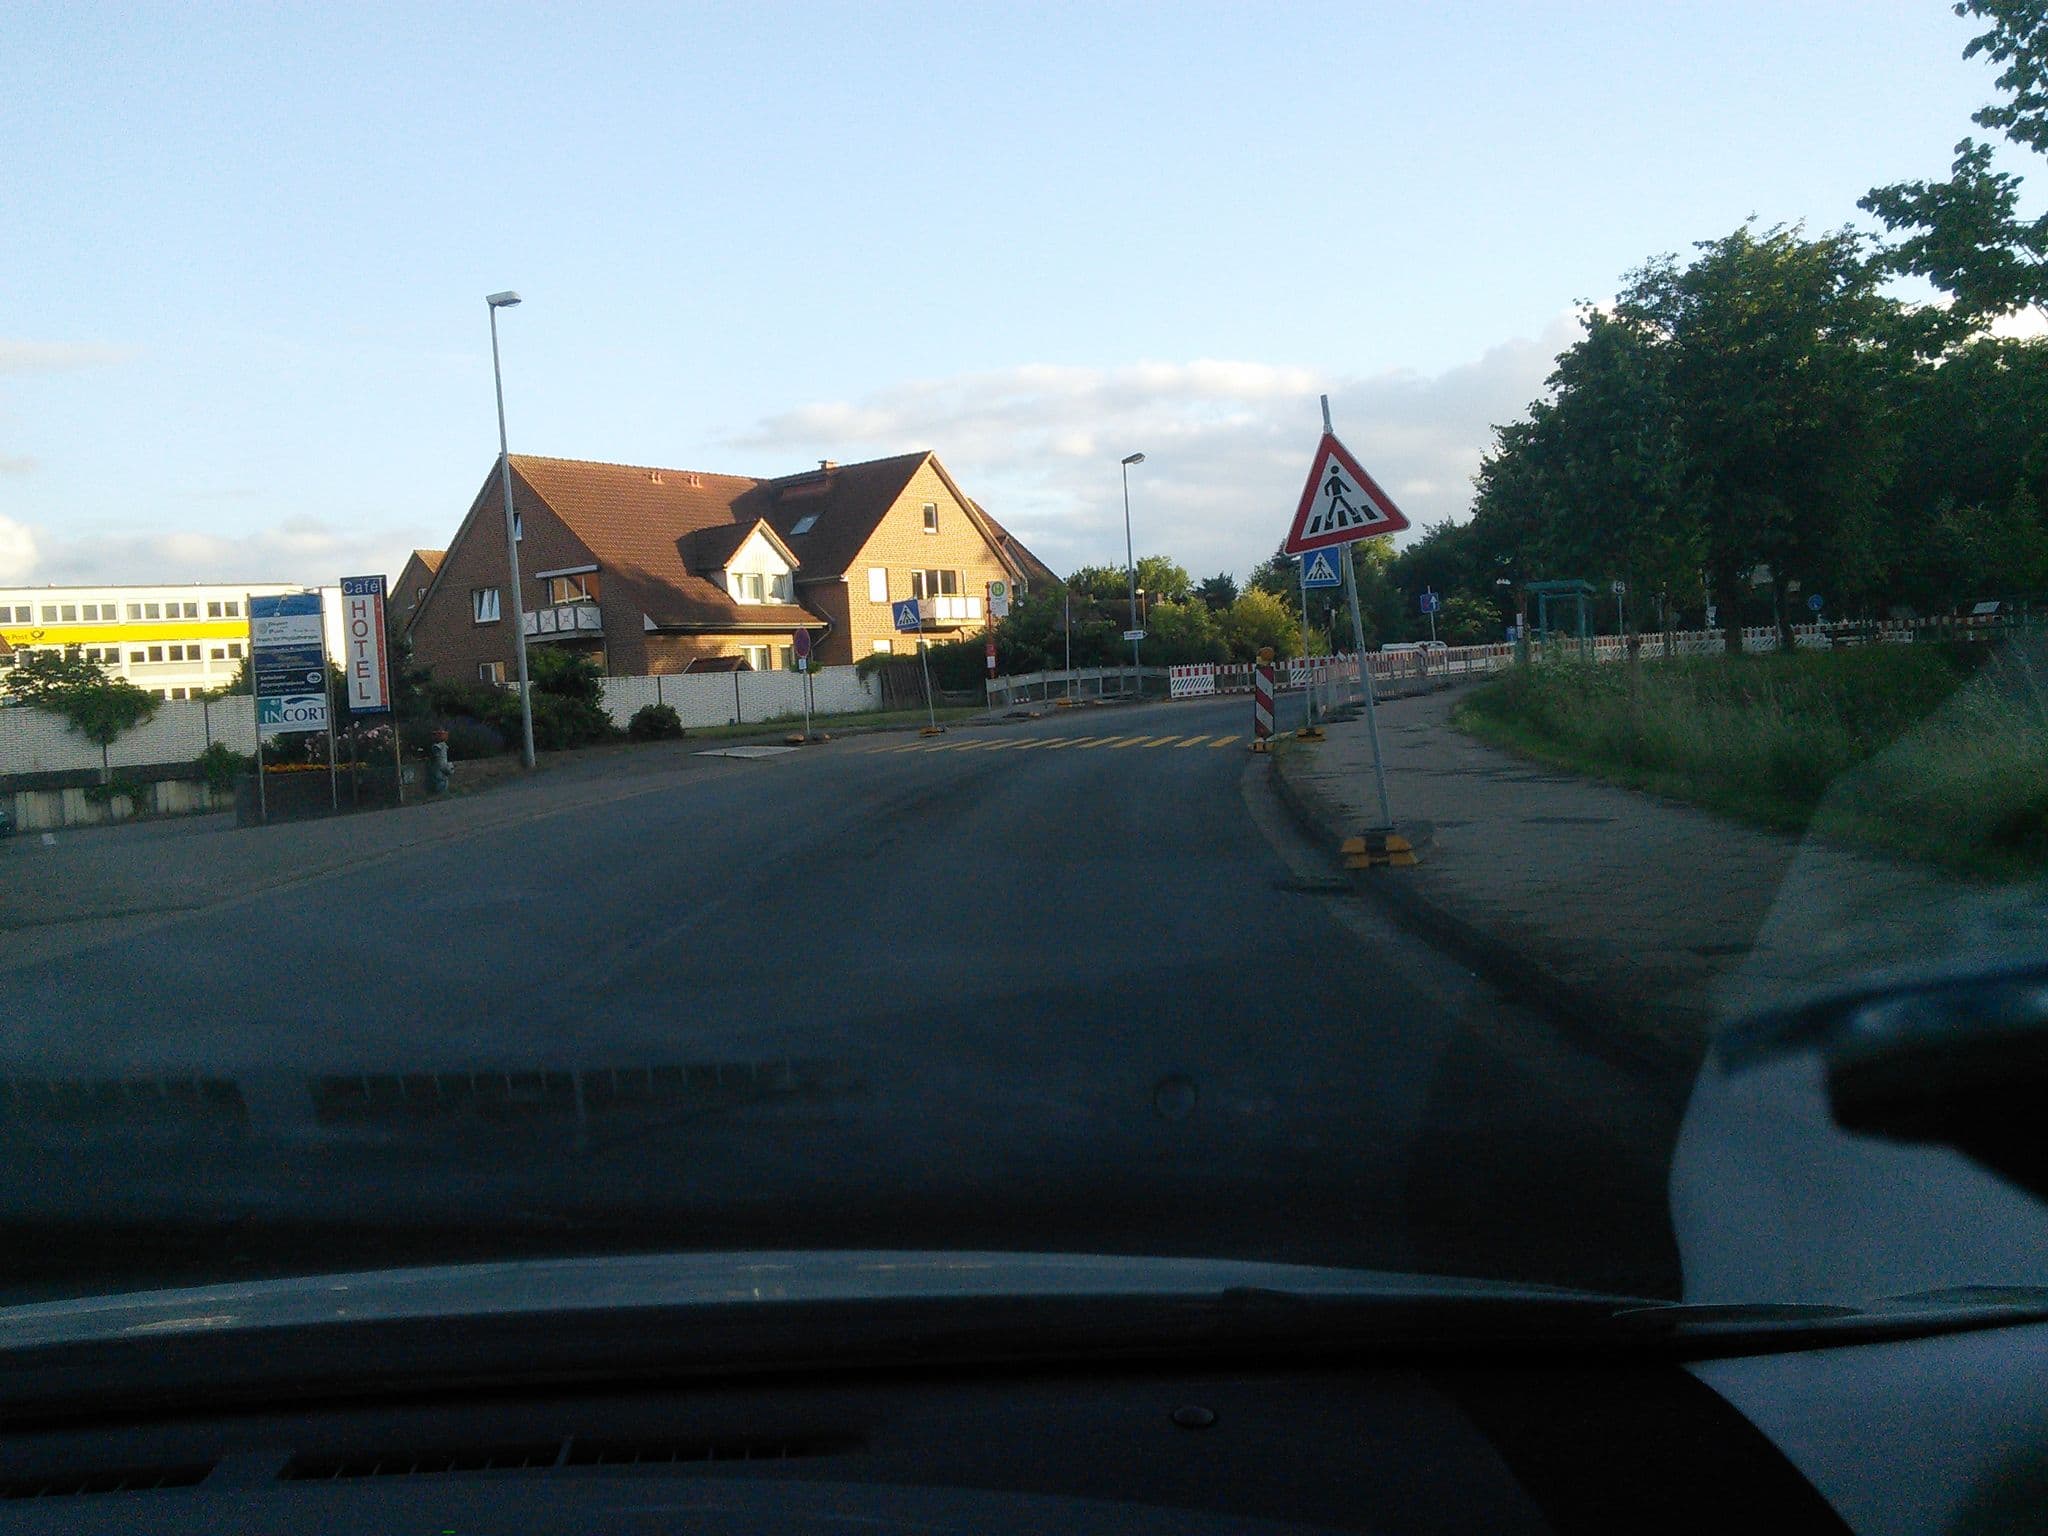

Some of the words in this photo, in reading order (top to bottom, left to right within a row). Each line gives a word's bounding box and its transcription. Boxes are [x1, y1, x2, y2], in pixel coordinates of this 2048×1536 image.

[343, 580, 378, 594] Café
[352, 600, 371, 701] HOTEL
[264, 705, 327, 724] INCORT
